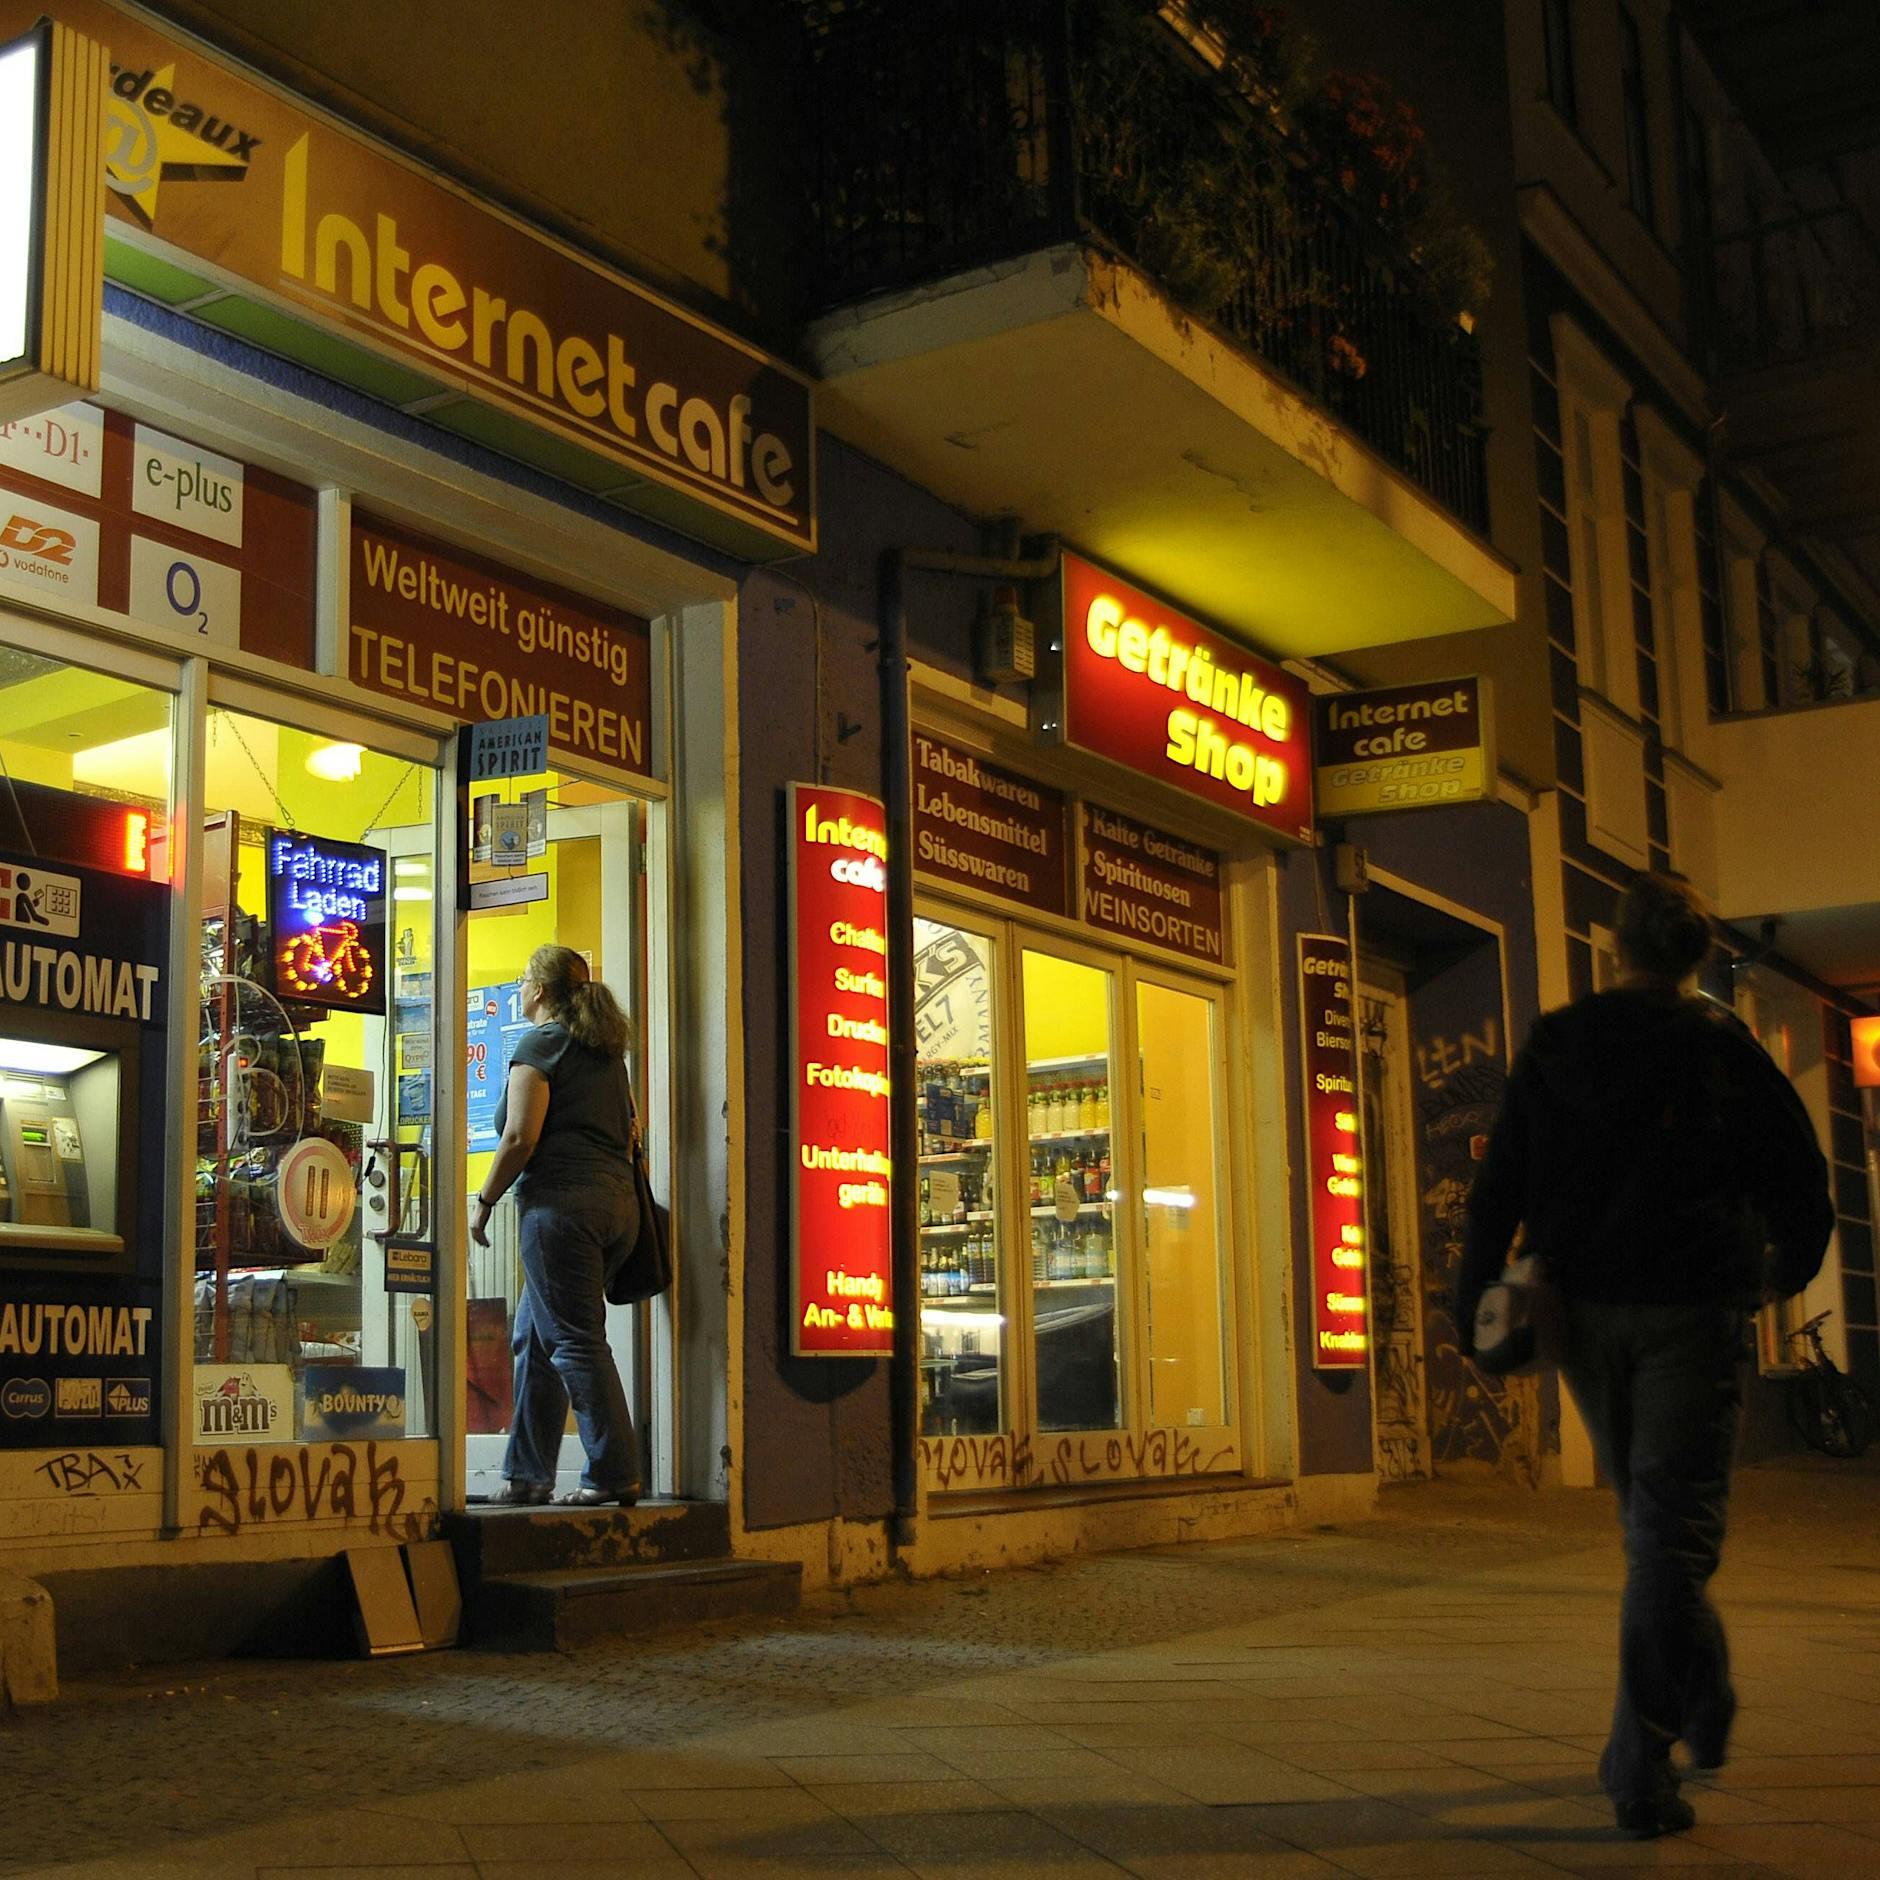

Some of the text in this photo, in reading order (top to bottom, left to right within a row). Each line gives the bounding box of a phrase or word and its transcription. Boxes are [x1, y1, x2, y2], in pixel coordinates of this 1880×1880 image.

[110, 63, 262, 162] deaux
[281, 131, 793, 506] Internet cafe
[146, 456, 232, 513] e-plus
[14, 558, 69, 583] vodafone
[364, 540, 628, 687] Weltweit günstig
[1086, 593, 1289, 743] Getränke
[352, 626, 642, 765] TELEFONIEREN
[1329, 690, 1468, 731] Internet
[478, 747, 541, 776] SPIRIT
[479, 731, 542, 750] AMERICAN
[1353, 728, 1427, 757] cafe
[916, 738, 1040, 811] Tabakwaren
[1332, 756, 1465, 788] Getränke
[917, 783, 1048, 856] Lebensmittel
[277, 840, 380, 892] Fahrrad
[918, 829, 1030, 893] Süsswaren
[1093, 810, 1215, 878] Kalte Getränke
[291, 880, 367, 920] Laden
[1094, 850, 1191, 908] Spirituosen
[0, 940, 159, 1020] UTOMAT
[470, 1088, 487, 1099] TAGE
[400, 1251, 428, 1263] Lebara
[826, 1271, 884, 1301] Handy
[0, 1303, 152, 1356] AUTOMAT
[803, 1303, 843, 1329] An-
[847, 1303, 864, 1329] &
[8, 1392, 46, 1404] Cirrus
[119, 1396, 149, 1412] PLUS
[322, 1393, 386, 1414] BOUNTY
